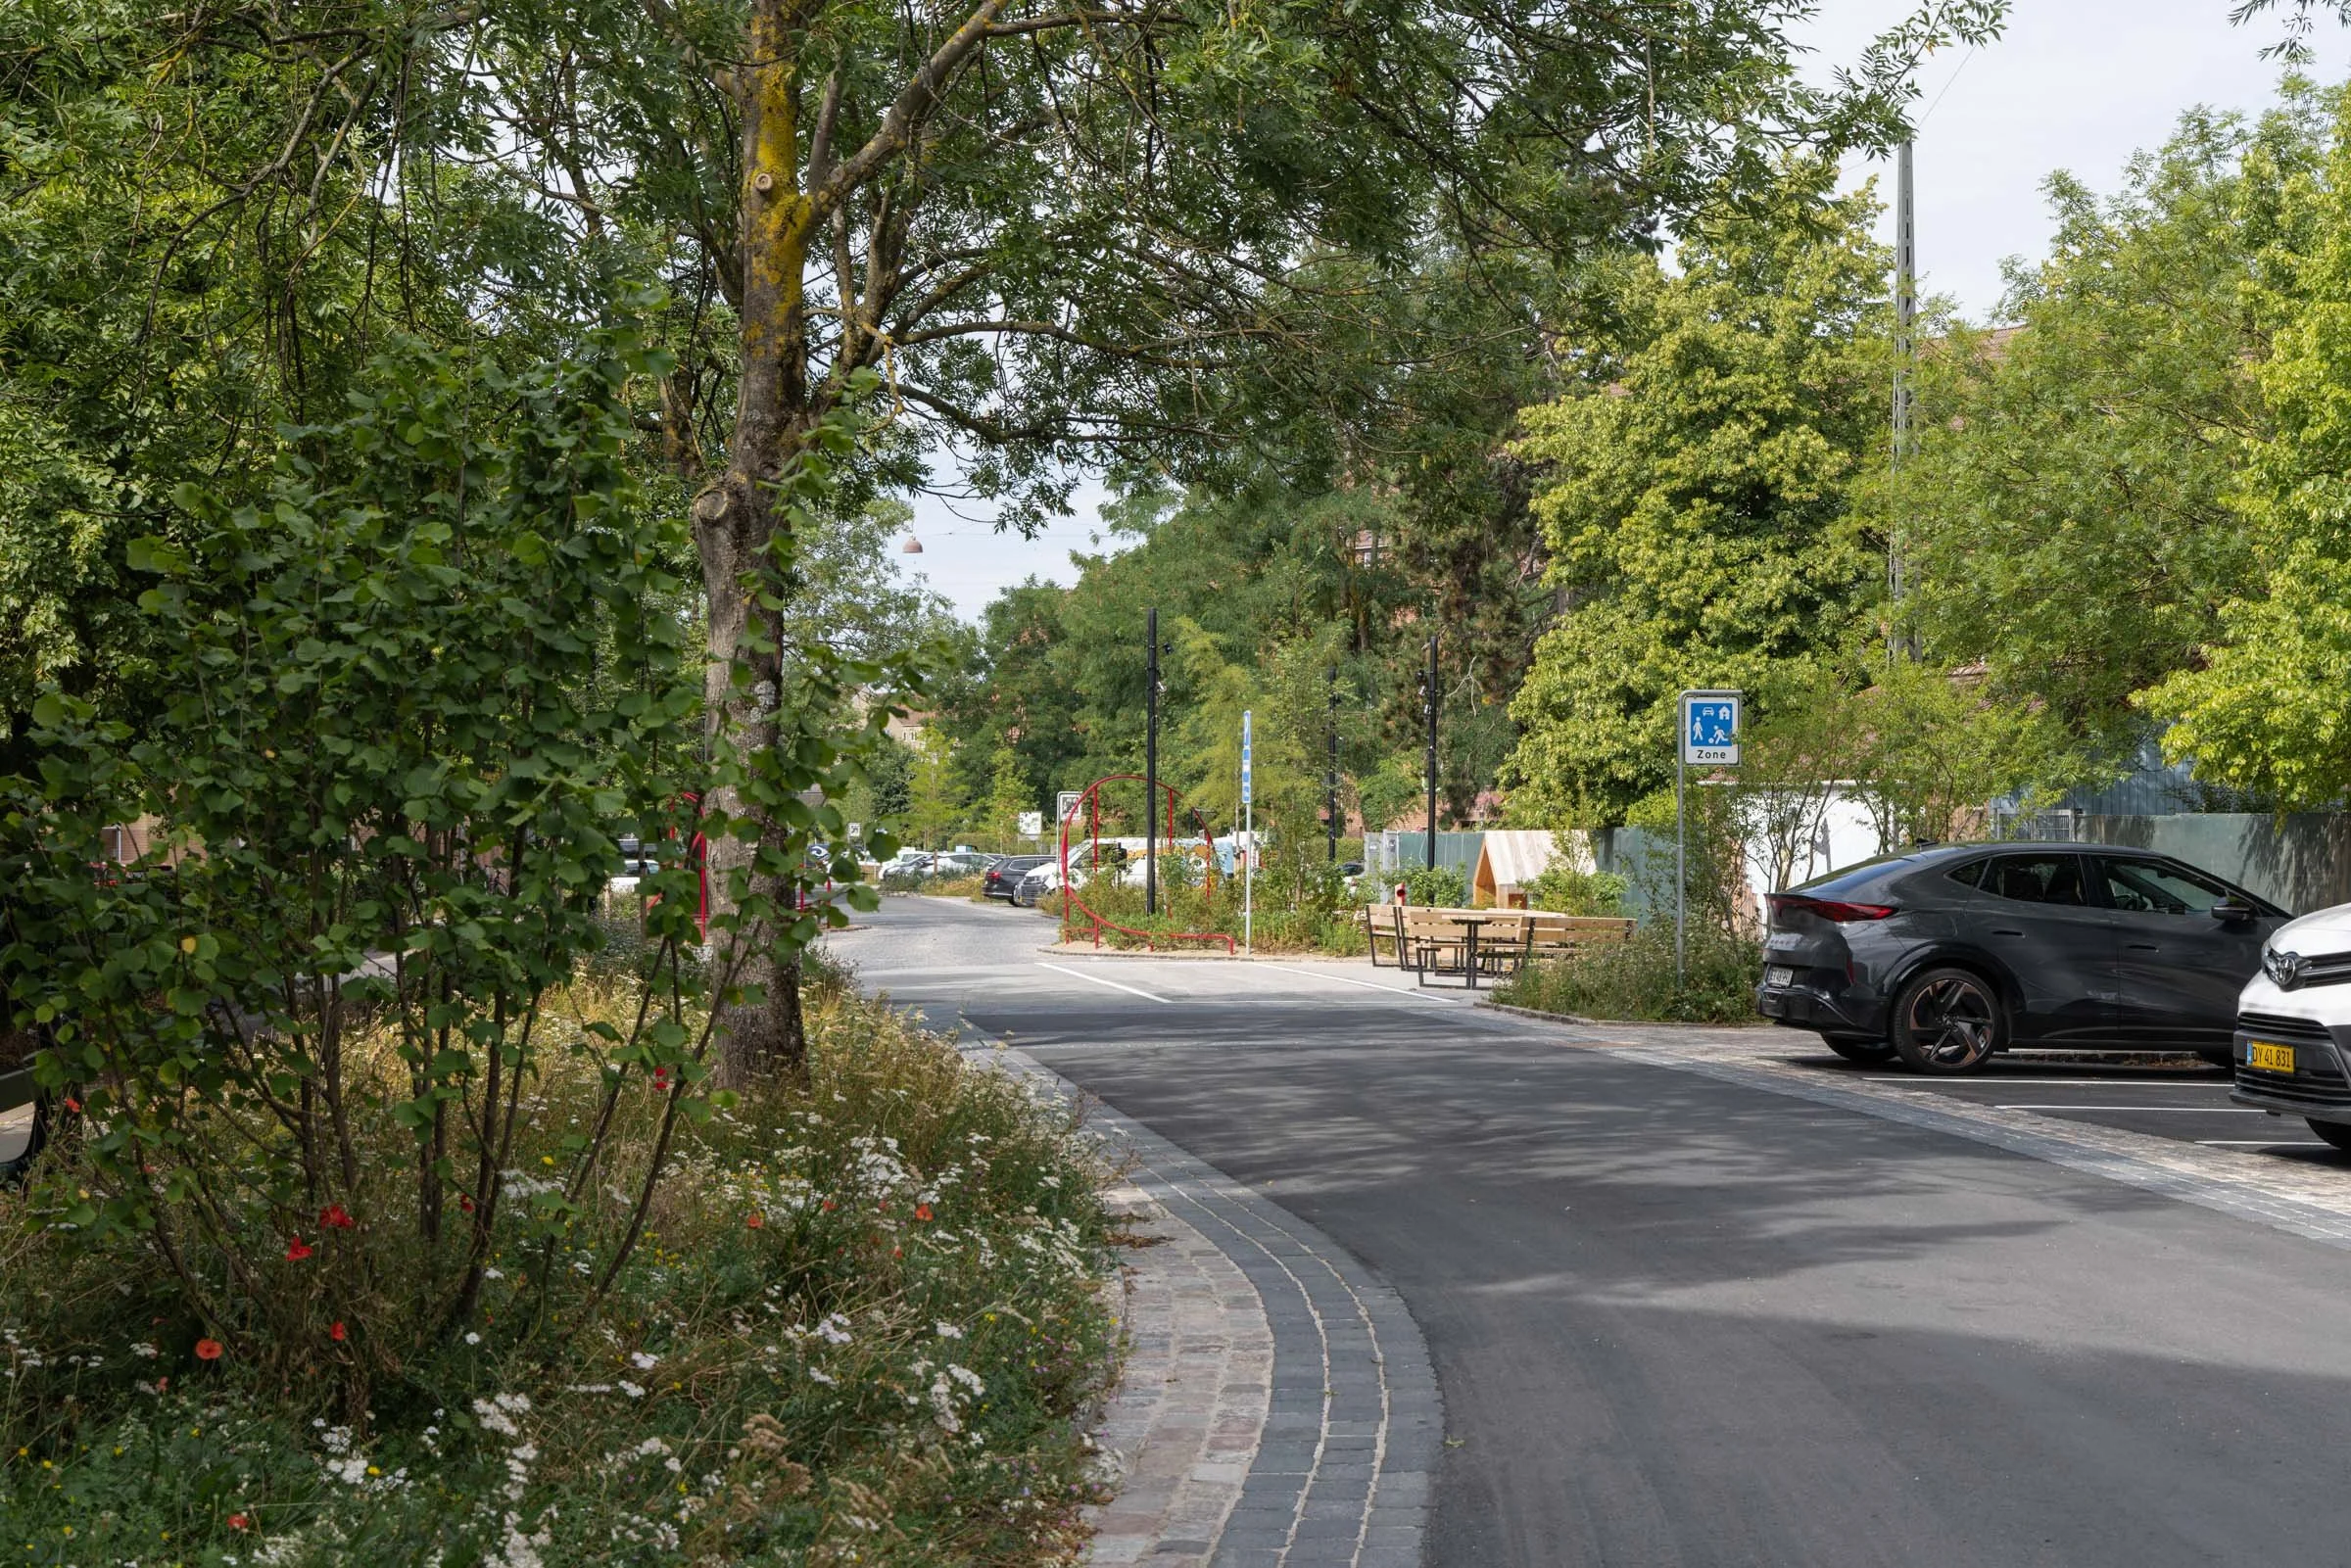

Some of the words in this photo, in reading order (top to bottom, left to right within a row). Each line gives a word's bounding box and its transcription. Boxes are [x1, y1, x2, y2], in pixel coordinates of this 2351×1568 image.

[1697, 749, 1726, 759] Zone
[2252, 1047, 2263, 1065] DY
[2264, 1048, 2273, 1066] 41
[2276, 1049, 2290, 1068] 831
